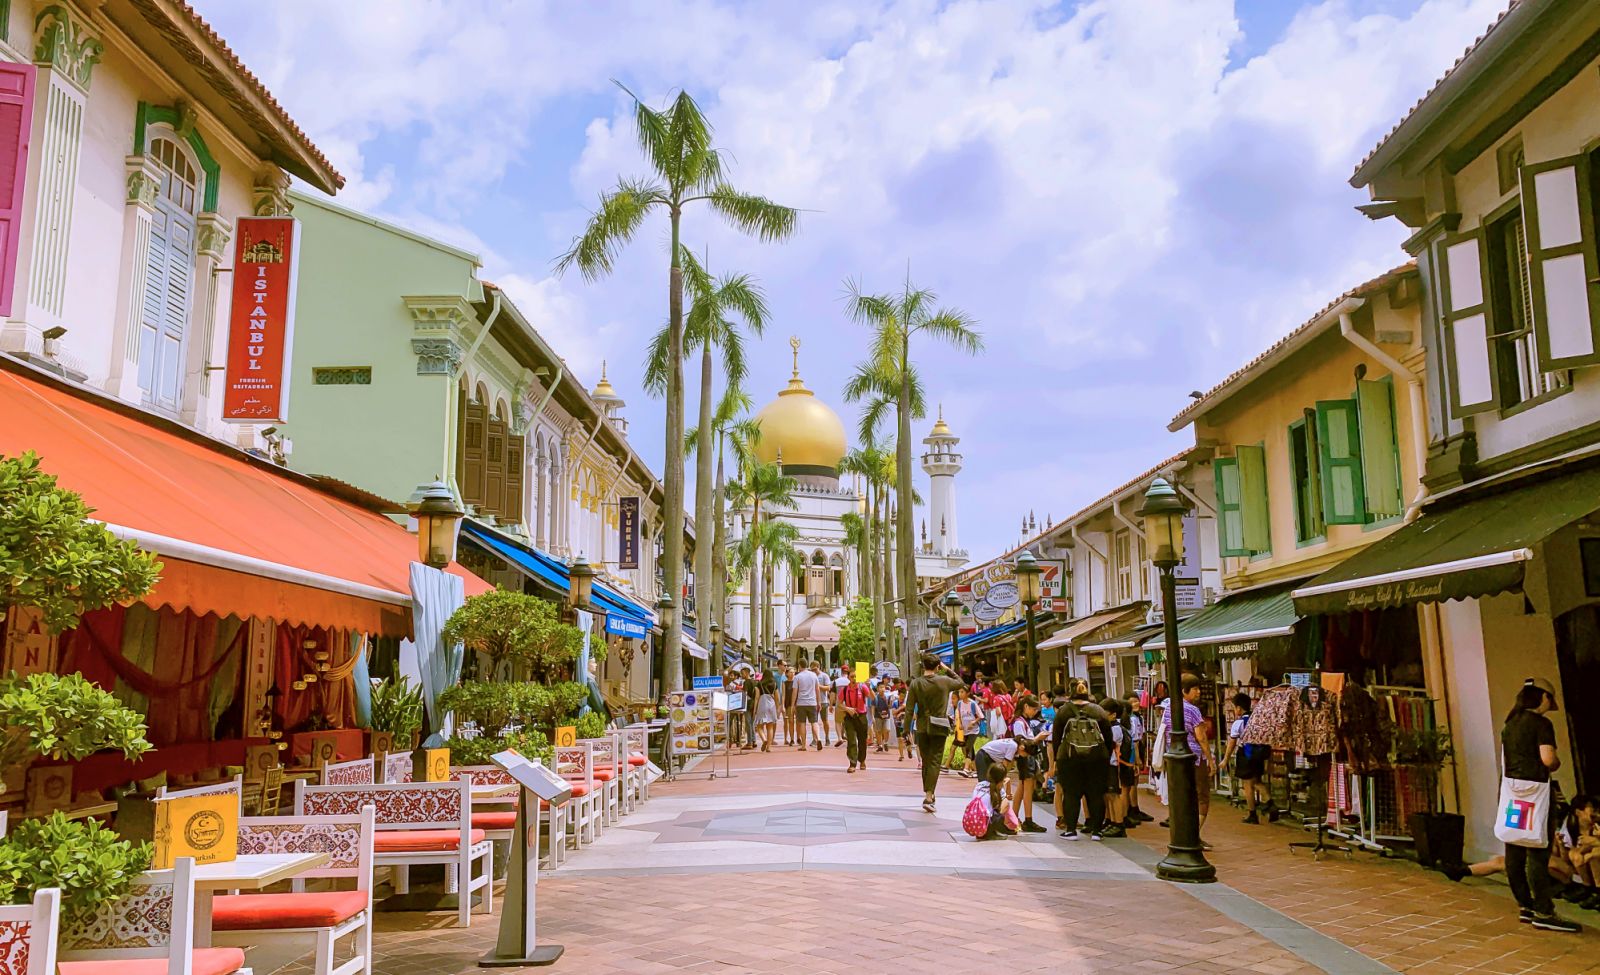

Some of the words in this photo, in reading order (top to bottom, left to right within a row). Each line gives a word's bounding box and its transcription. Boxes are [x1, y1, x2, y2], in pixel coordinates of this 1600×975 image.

[248, 266, 268, 370] ISTANBUL
[1039, 565, 1059, 581] 7
[1394, 583, 1403, 607] by
[1042, 599, 1052, 608] 24
[24, 615, 42, 667] AN
[1218, 646, 1224, 654] 25
[1224, 644, 1243, 654] BUSSORAH
[1244, 642, 1259, 652] STREET
[195, 853, 216, 862] urkish
